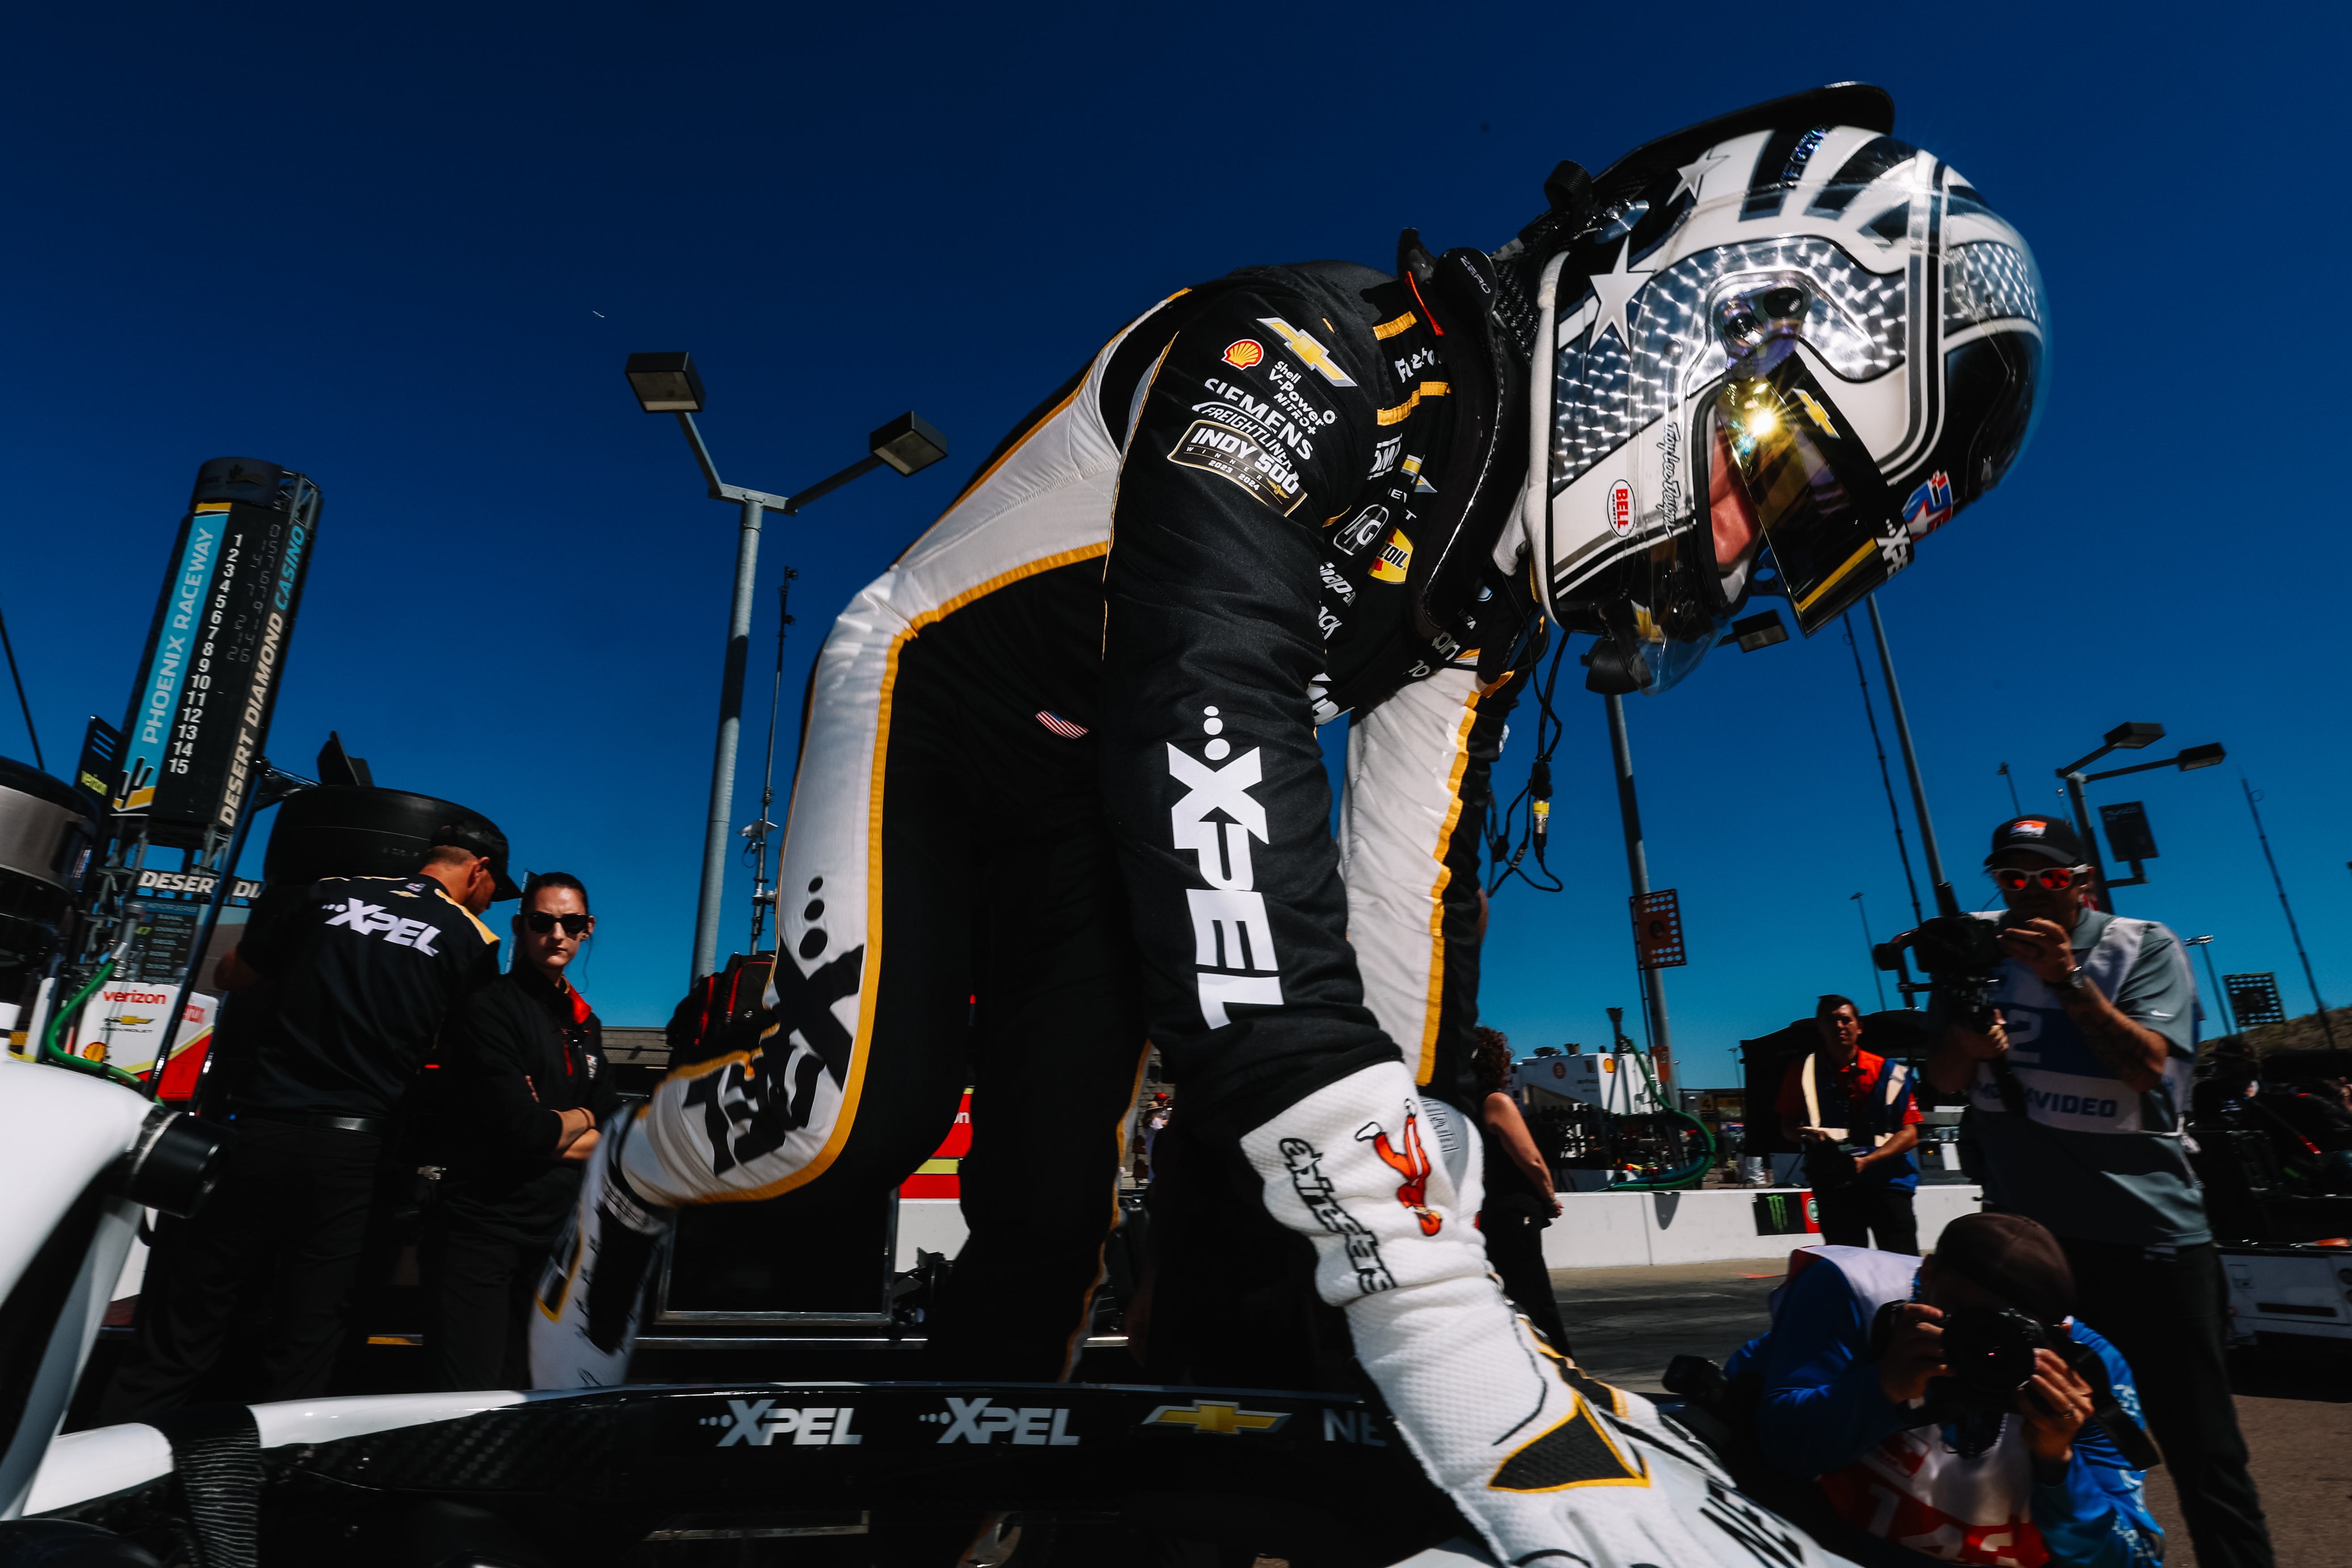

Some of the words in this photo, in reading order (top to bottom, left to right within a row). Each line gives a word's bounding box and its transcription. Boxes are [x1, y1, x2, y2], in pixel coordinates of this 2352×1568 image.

[1460, 255, 1491, 293] ZERO
[1274, 361, 1302, 384] Shell
[1269, 368, 1325, 426] V-Power
[1204, 378, 1313, 460] SIEMENS
[1186, 446, 1263, 480] WINNER
[1191, 428, 1258, 459] INDY
[1254, 453, 1300, 495] 500
[1208, 460, 1233, 474] 2023
[1238, 474, 1260, 491] 2024
[1616, 489, 1628, 528] BELL
[234, 533, 243, 547] 1
[227, 548, 240, 563] 2
[223, 564, 235, 577] 3
[219, 579, 231, 593] 4
[214, 595, 227, 609] 5
[210, 610, 222, 625] 6
[141, 635, 185, 744] PHOENIX
[173, 528, 214, 629] RACEWAY
[207, 626, 220, 640] 7
[201, 641, 215, 656] 8
[197, 658, 210, 672] 9
[191, 675, 211, 689] 10
[220, 728, 254, 827] DESERT
[244, 613, 283, 728] DIAMOND
[275, 525, 305, 610] CASINO
[186, 690, 207, 706] 11
[182, 708, 203, 724] 12
[178, 725, 198, 740] 13
[173, 740, 193, 756] 14
[168, 759, 190, 774] 15
[1166, 742, 1284, 1030] XPEL
[324, 897, 441, 957] XPEL
[103, 989, 167, 1004] verizon
[716, 1399, 863, 1447] XPEL
[936, 1397, 1081, 1446] XPEL
